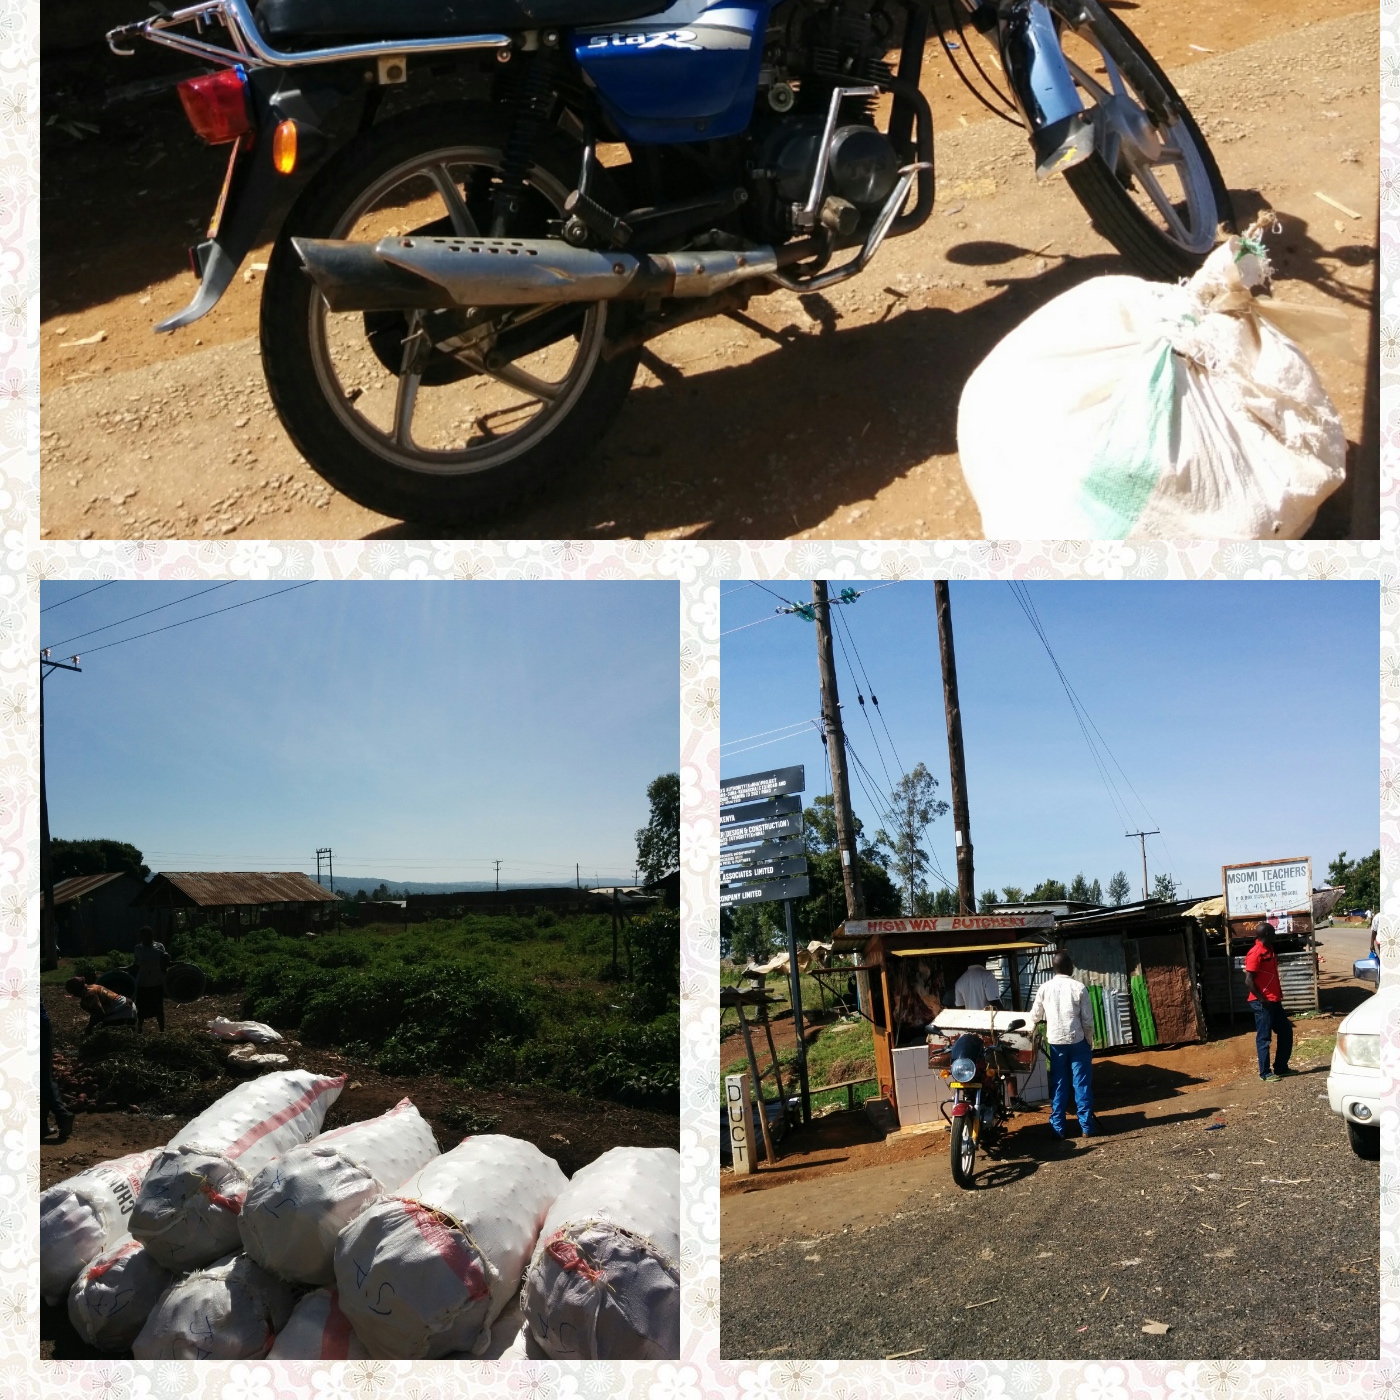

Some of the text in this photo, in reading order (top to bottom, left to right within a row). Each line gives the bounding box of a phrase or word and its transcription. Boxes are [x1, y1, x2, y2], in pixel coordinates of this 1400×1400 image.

[722, 866, 774, 881] ASSOCIATES LIMITED
[1227, 865, 1307, 884] MSOMI TEACHERS
[742, 889, 763, 899] LIMITED
[1248, 880, 1286, 894] COLLEGE
[867, 916, 1027, 932] HIGH WAY BUTCHERY
[727, 1084, 747, 1162] DUCT
